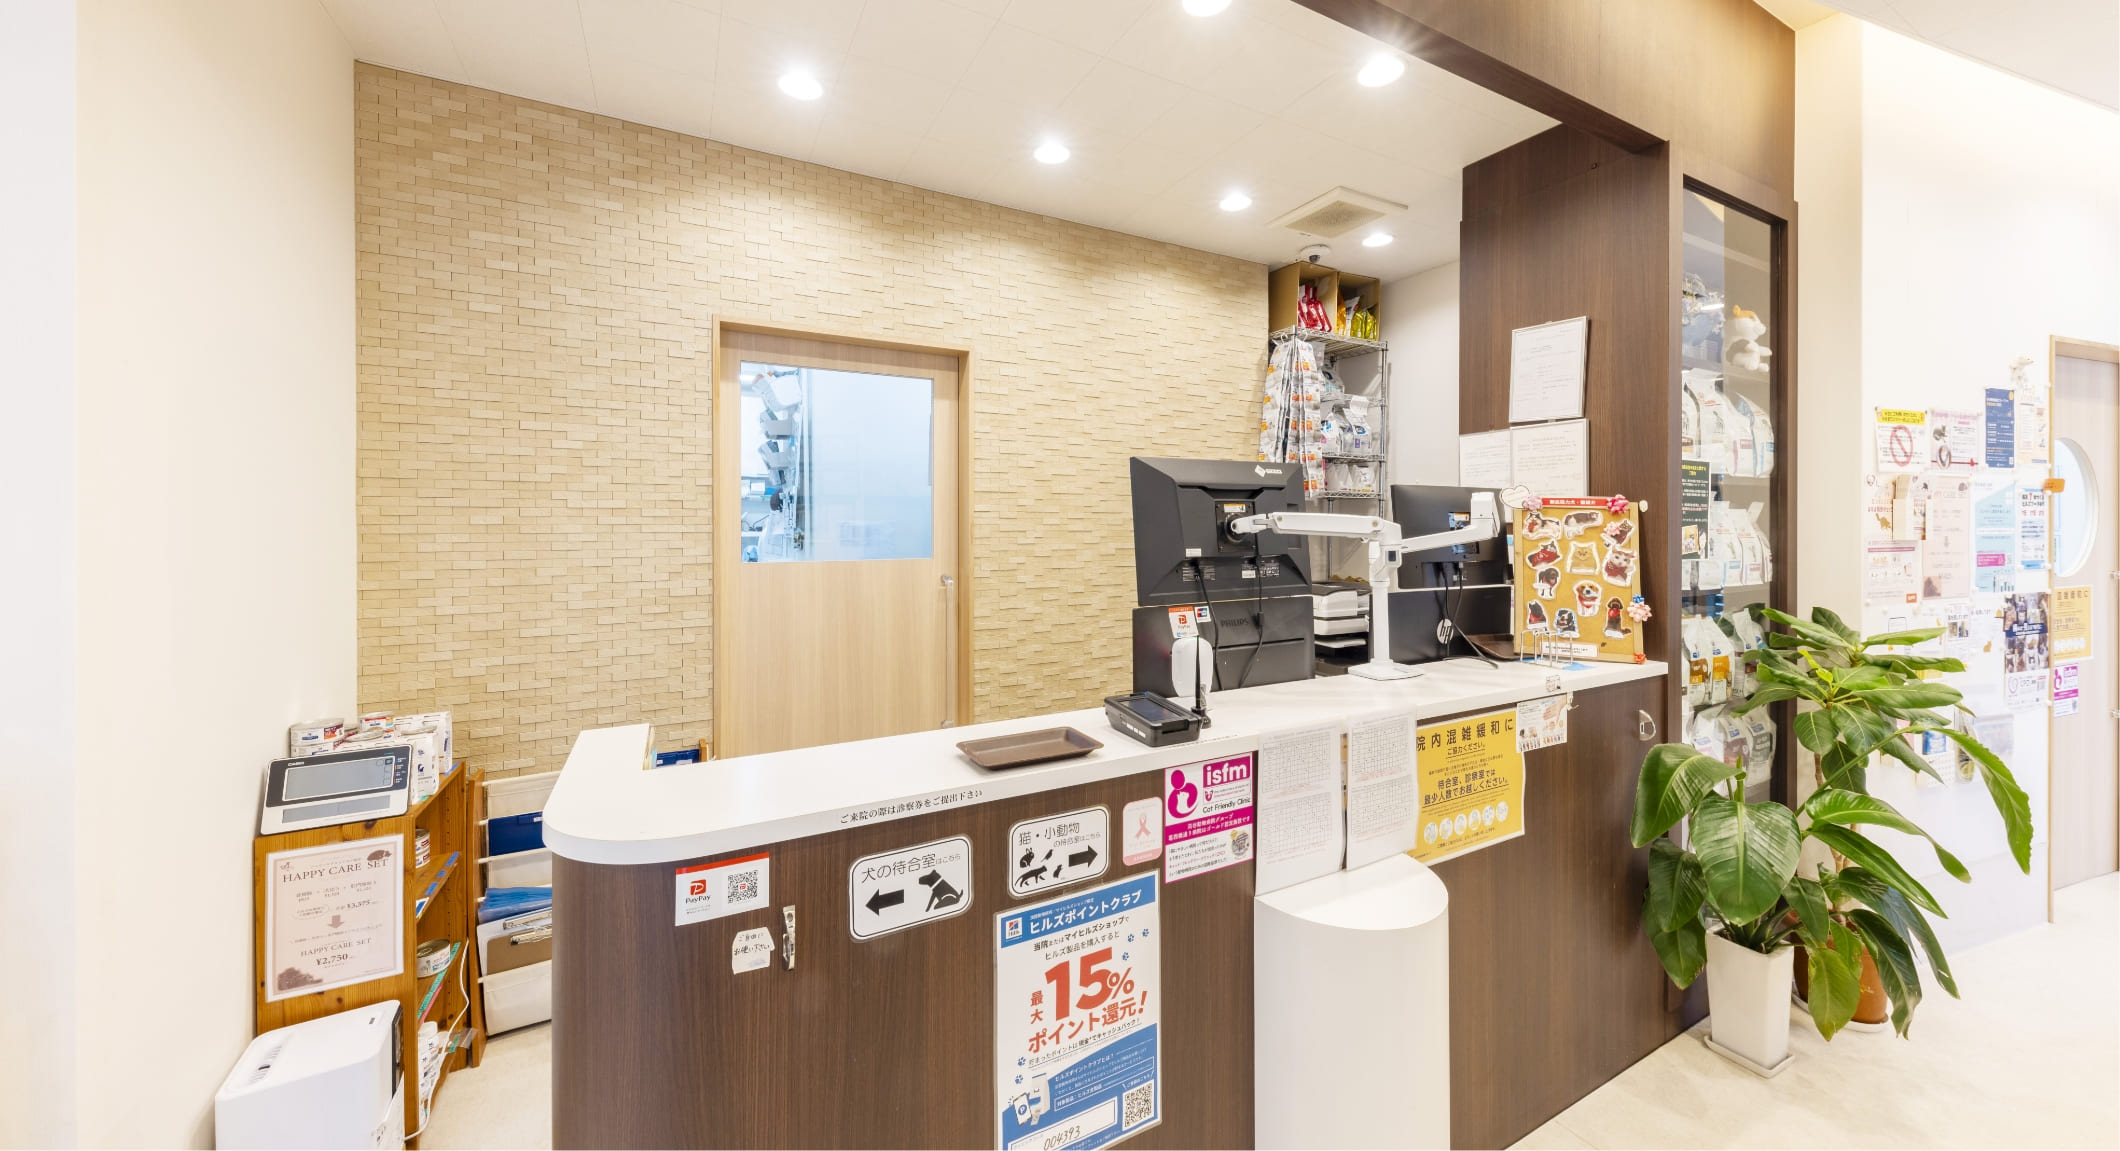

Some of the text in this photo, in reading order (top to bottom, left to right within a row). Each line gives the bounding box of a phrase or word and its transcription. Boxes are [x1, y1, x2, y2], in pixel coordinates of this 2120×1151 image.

[1220, 617, 1249, 627] PHILIPS
[1416, 717, 1514, 752] 院内混雑緩和に
[1206, 763, 1247, 786] isfm
[840, 790, 983, 824] ご来院の際は診察券をご提出下さい
[1202, 797, 1251, 813] Cat Friendly Clinic
[1018, 822, 1080, 846] 猫・小動物
[283, 859, 389, 883] HAPPY CARE SET
[685, 895, 712, 905] PayPay
[1029, 889, 1142, 935] ヒルズポイントクラブ
[1033, 914, 1130, 952] 当院またはマイヒルズショップで
[1045, 930, 1120, 961] ヒルズ製品を購入すると
[300, 946, 329, 957] HAPPY
[330, 941, 352, 951] CARE
[315, 953, 348, 966] ¥2,750
[1045, 946, 1135, 1021] 15%
[1030, 990, 1044, 1024] 最大
[1043, 1125, 1081, 1151] 004393
